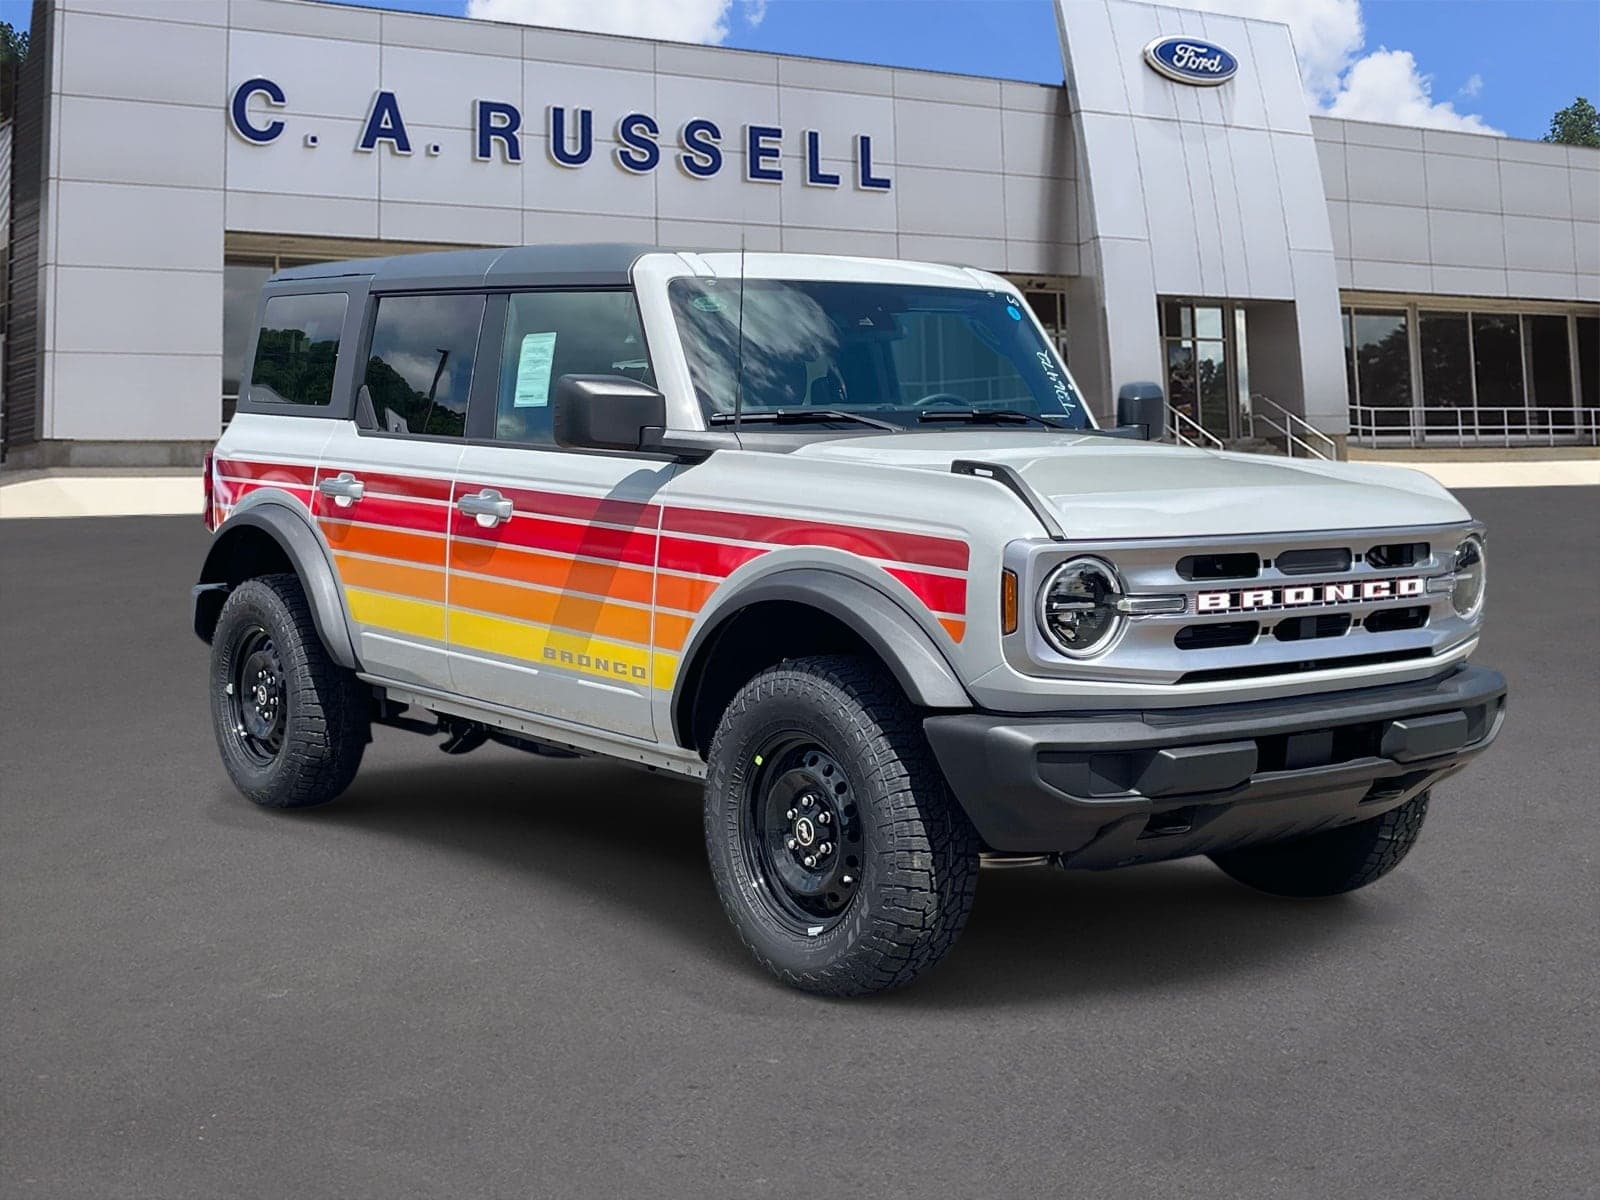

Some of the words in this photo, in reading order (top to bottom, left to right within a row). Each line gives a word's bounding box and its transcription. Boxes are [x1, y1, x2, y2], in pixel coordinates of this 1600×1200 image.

[1173, 44, 1222, 72] Ford
[231, 77, 319, 146] C.
[355, 88, 442, 155] A.
[474, 98, 893, 191] RUSSELL
[1196, 578, 1425, 613] BRONCO
[543, 646, 646, 679] BRONCO
